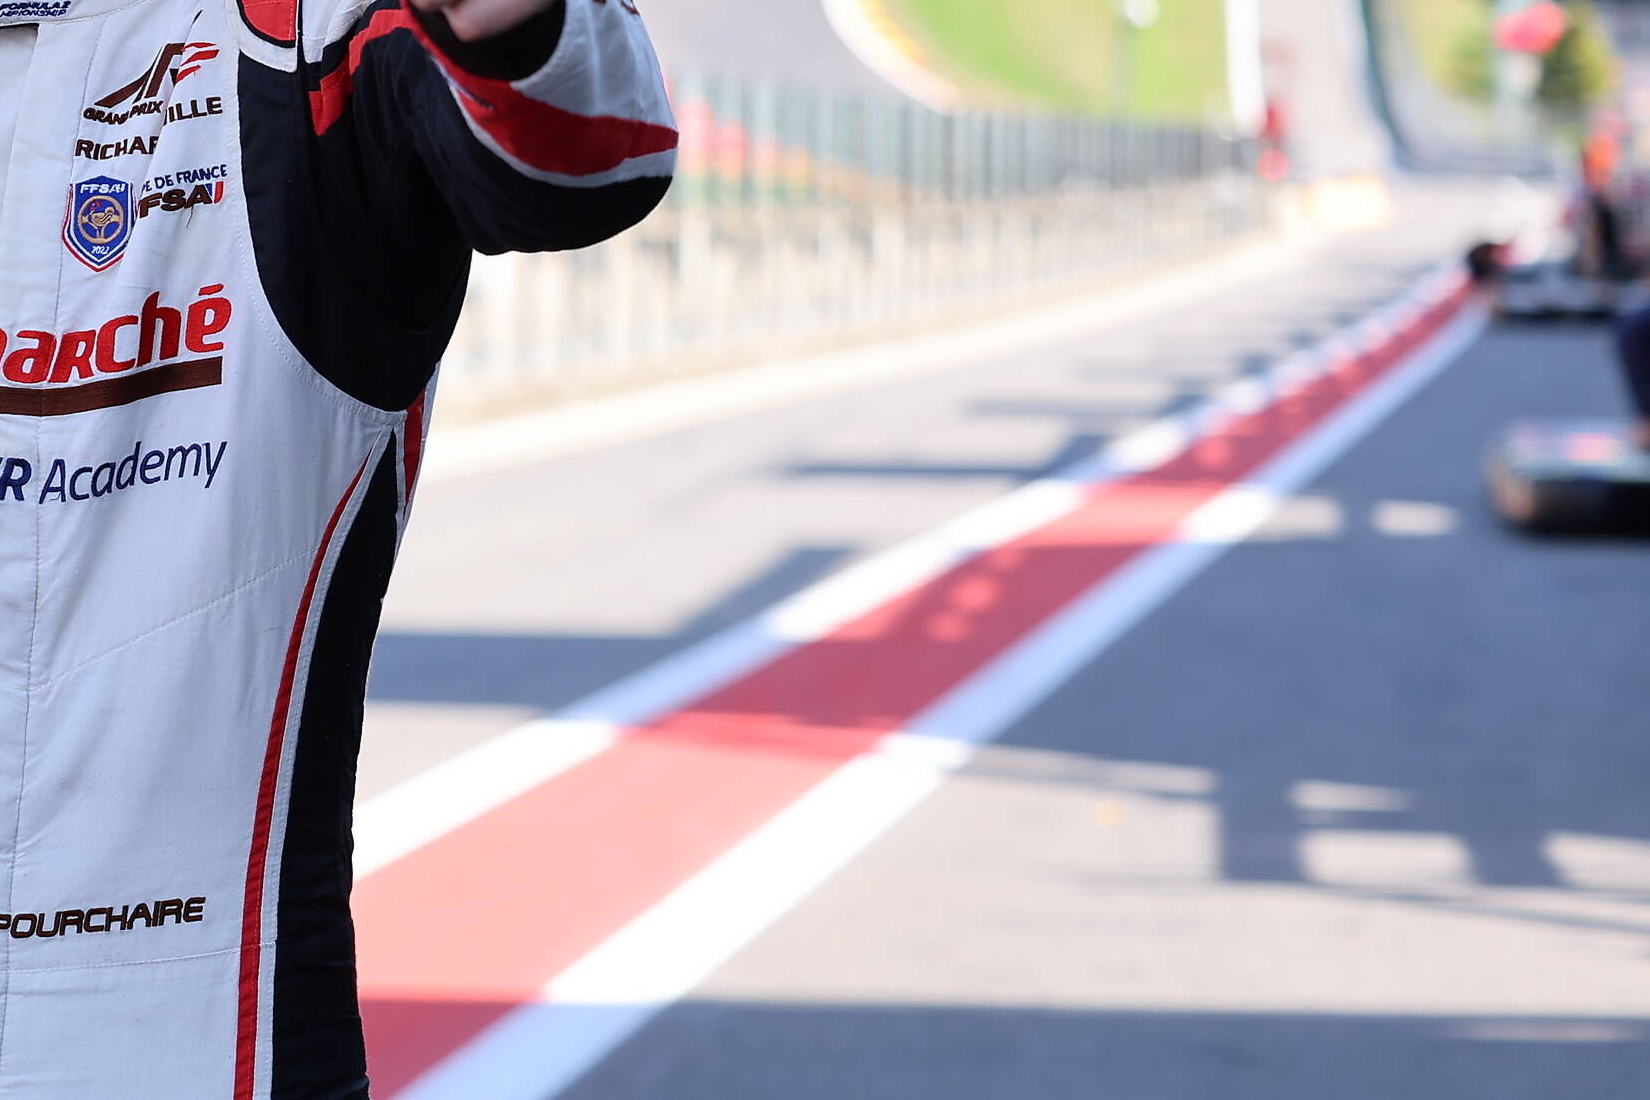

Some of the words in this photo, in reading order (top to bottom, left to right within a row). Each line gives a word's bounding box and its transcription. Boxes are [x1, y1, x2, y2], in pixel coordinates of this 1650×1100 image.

[83, 107, 130, 125] GRAND
[129, 101, 164, 119] PRIX
[163, 96, 223, 126] ILLE
[154, 175, 175, 190] DE
[176, 164, 228, 184] FRANCE
[138, 184, 213, 219] FSA
[39, 440, 229, 504] Academy
